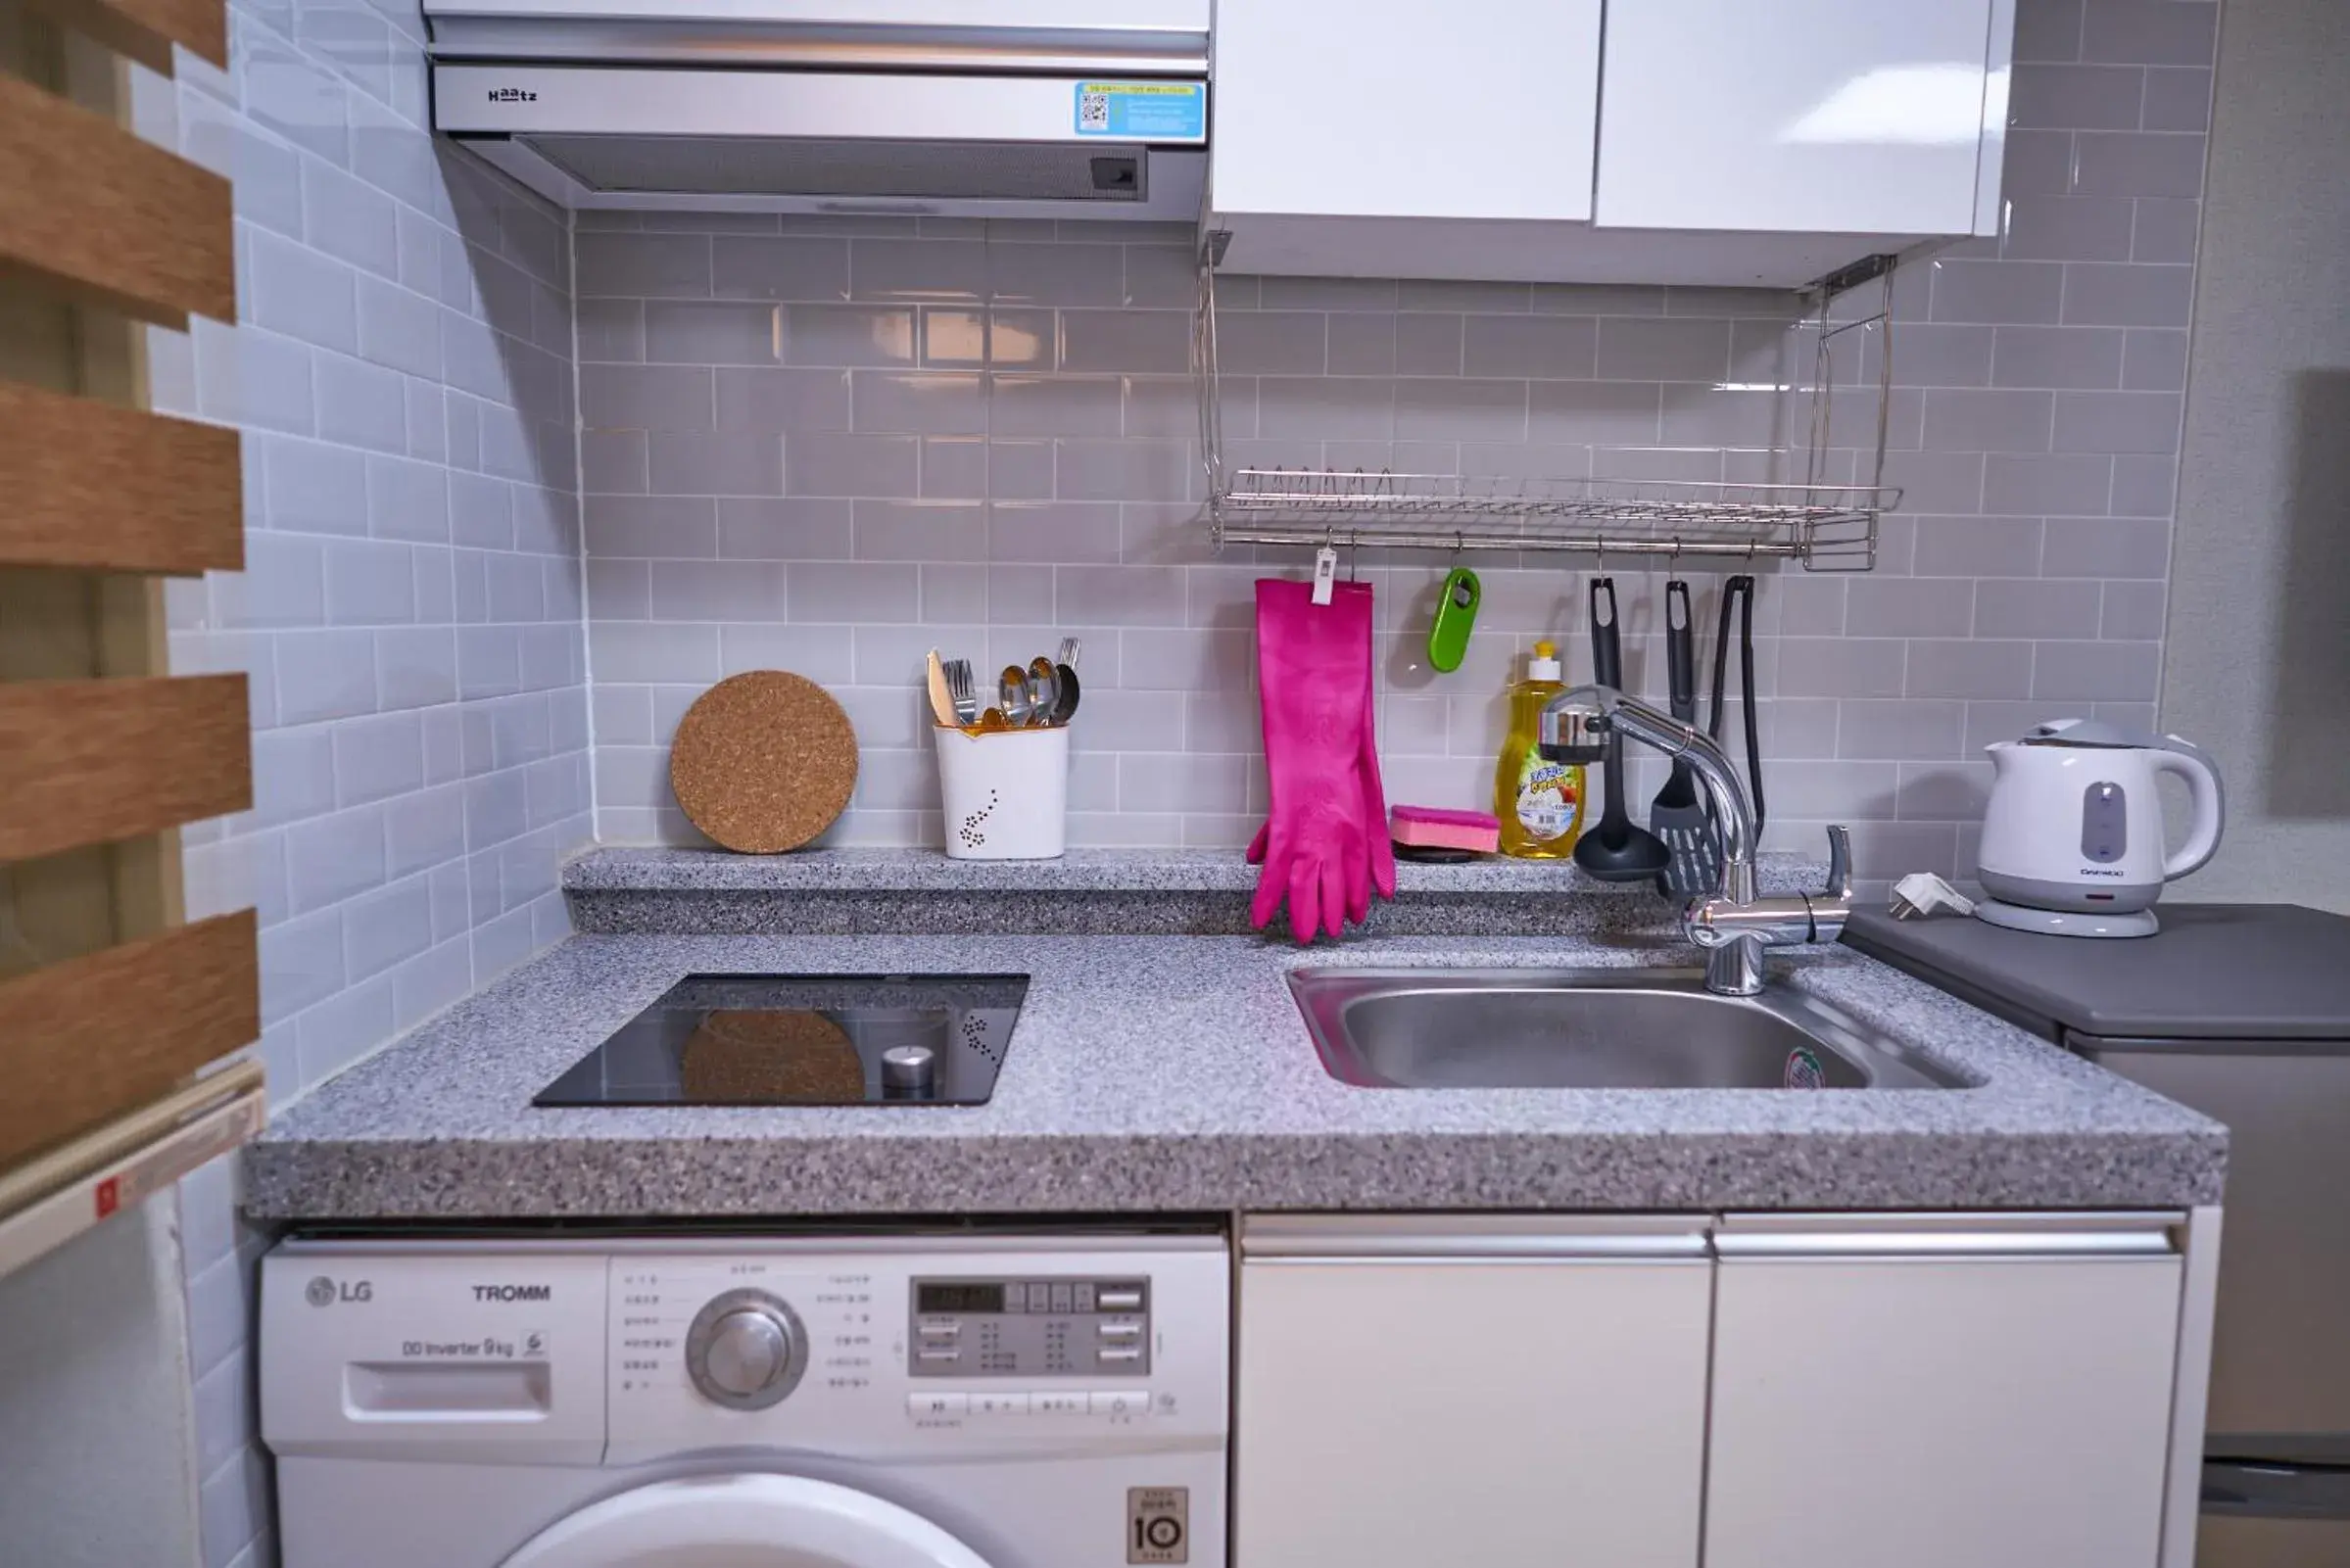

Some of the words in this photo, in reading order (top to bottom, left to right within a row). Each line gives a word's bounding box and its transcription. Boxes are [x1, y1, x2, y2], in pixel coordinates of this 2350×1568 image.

[488, 88, 538, 102] Haatz
[340, 1280, 373, 1304] LG
[472, 1284, 552, 1303] TROMM
[425, 1340, 480, 1357] Inverter
